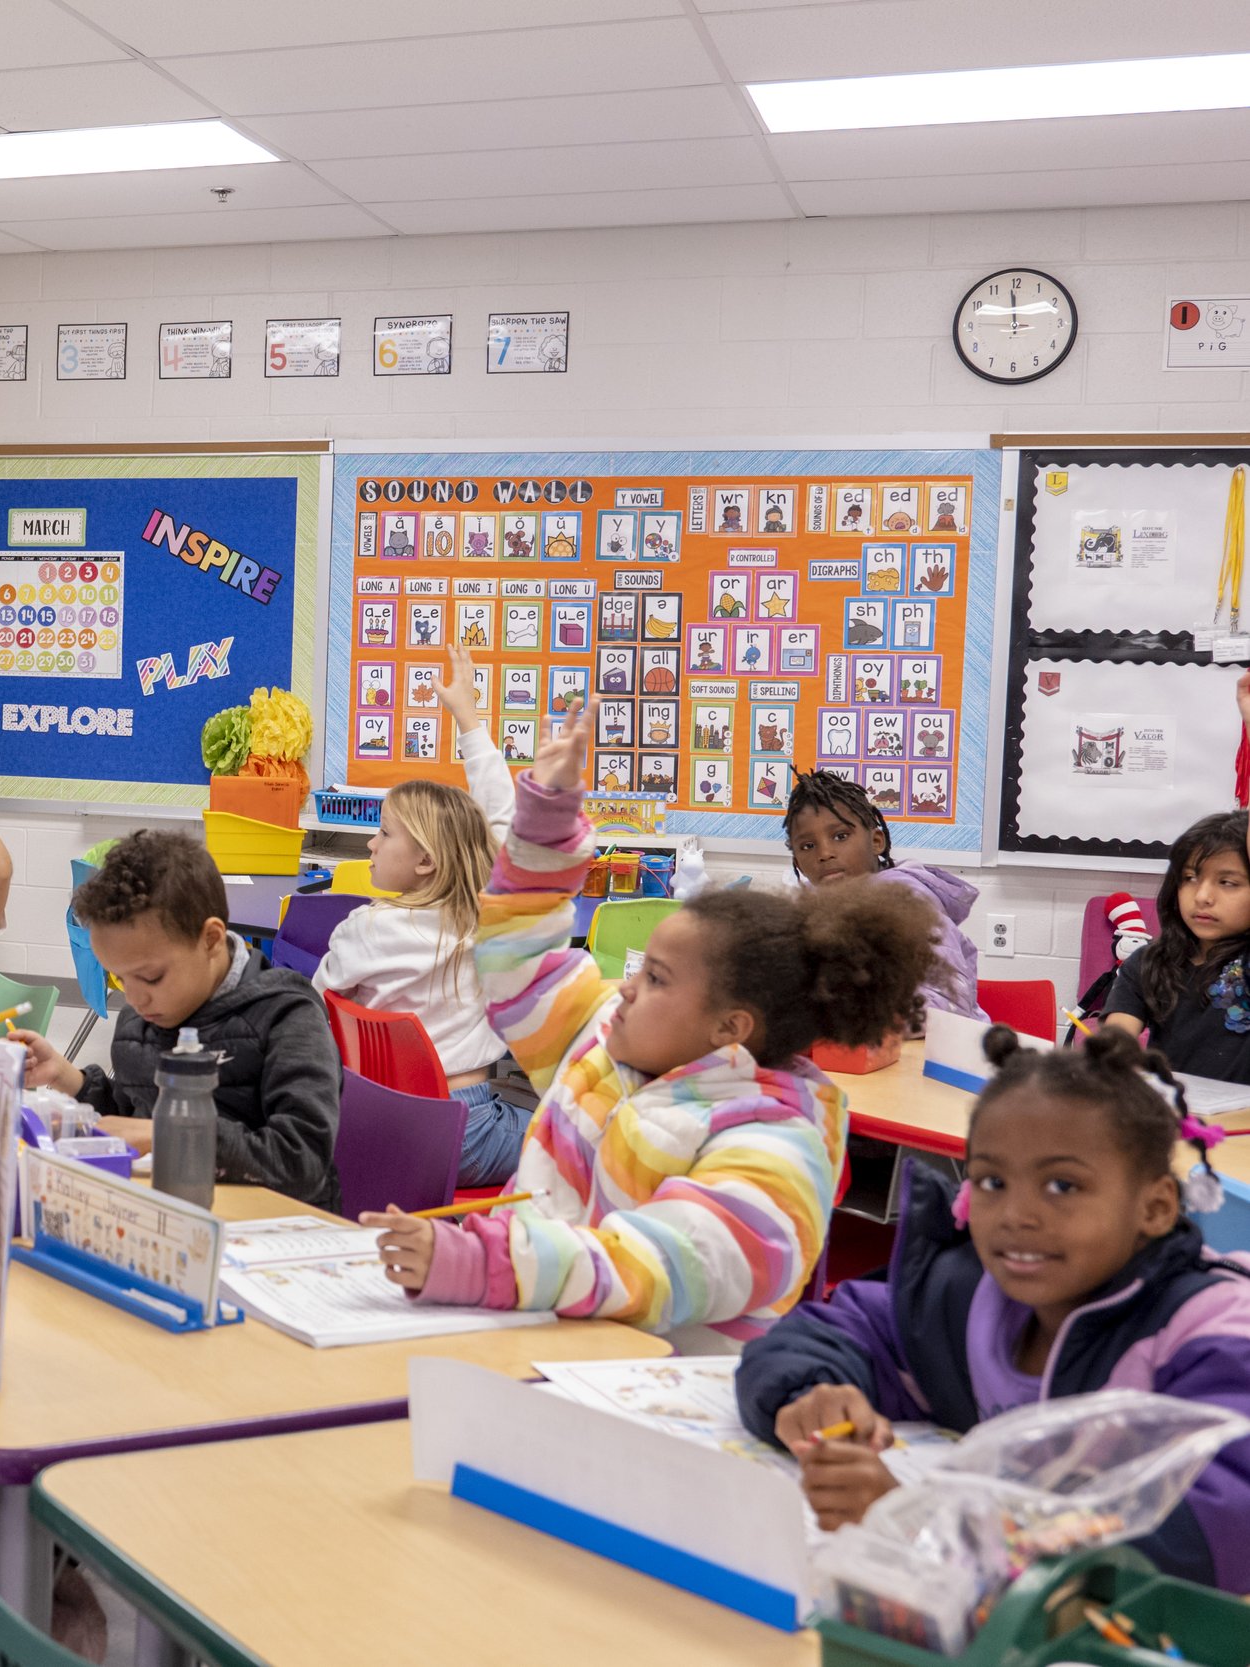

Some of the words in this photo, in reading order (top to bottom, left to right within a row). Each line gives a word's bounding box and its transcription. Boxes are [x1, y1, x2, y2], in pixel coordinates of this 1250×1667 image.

[1012, 278, 1021, 289] 12
[1037, 283, 1041, 293] 1
[989, 285, 999, 295] 11
[1052, 297, 1058, 308] 2
[494, 336, 511, 365] 7
[1050, 340, 1056, 350] 4
[60, 344, 79, 373] 3
[163, 345, 184, 372] 4
[270, 343, 287, 371] 5
[378, 338, 399, 368] 6
[989, 357, 994, 368] 7
[1033, 356, 1039, 366] 5
[1010, 362, 1016, 373] 6
[1052, 475, 1061, 486] L
[364, 480, 475, 503] SOUND
[496, 480, 588, 503] WALL
[815, 487, 824, 495] ED
[843, 489, 864, 503] ed
[890, 488, 911, 502] ed
[937, 488, 958, 501] ed
[621, 493, 626, 503] Y
[630, 493, 660, 504] VOWEL
[721, 493, 744, 504] wr
[766, 491, 786, 504] kn
[692, 495, 704, 530] LETTERS
[813, 505, 823, 530] SOUNDS
[22, 519, 71, 536] MARCH
[613, 519, 623, 532] y
[656, 519, 666, 532] y
[363, 525, 372, 552] VOWELS
[140, 508, 282, 605] INSPIRE
[736, 554, 774, 562] CONTROLLED
[874, 550, 895, 563] ch
[922, 550, 943, 563] th
[811, 565, 858, 576] DIGRAPHS
[624, 574, 659, 585] SOUNDS
[720, 578, 740, 589] or
[766, 578, 787, 590] ar
[361, 582, 383, 592] LONG
[389, 582, 395, 592] A
[410, 582, 433, 592] LONG
[438, 582, 443, 592] E
[458, 583, 480, 593] LONG
[487, 583, 492, 593] I
[505, 584, 528, 594] LONG
[535, 584, 541, 594] O
[554, 585, 577, 595] LONG
[584, 585, 591, 595] U
[604, 597, 633, 613] dge
[856, 602, 876, 616] sh
[21, 610, 34, 622] 14
[40, 611, 53, 622] 15
[364, 607, 391, 619] a_e
[413, 607, 439, 619] e_e
[464, 606, 484, 619] i_e
[509, 608, 537, 620] o_e
[557, 608, 585, 621] u_e
[902, 604, 924, 620] ph
[19, 632, 32, 643] 21
[697, 630, 717, 642] ur
[747, 630, 759, 642] ir
[788, 631, 807, 643] er
[606, 652, 627, 663] oo
[651, 651, 669, 665] all
[136, 636, 235, 696] PLAY
[863, 662, 884, 676] oy
[912, 661, 927, 674] oi
[370, 667, 383, 679] ai
[414, 669, 432, 681] ea
[511, 672, 530, 683] oa
[563, 673, 576, 685] ui
[832, 657, 842, 700] DIPHTHONGS
[691, 685, 707, 693] SOFT
[709, 686, 735, 694] SOUNDS
[760, 686, 796, 696] SPELLING
[604, 703, 626, 716] ink
[648, 705, 670, 720] ing
[2, 704, 134, 737] EXPLORE
[708, 711, 717, 721] c
[767, 712, 777, 722] c
[828, 715, 850, 726] oo
[365, 719, 383, 732] ay
[412, 721, 431, 731] ee
[507, 723, 530, 734] ow
[921, 717, 943, 728] ou
[653, 759, 662, 770] s
[707, 764, 716, 777] g
[766, 763, 775, 776] k
[872, 771, 893, 782] au
[917, 772, 942, 783] aw
